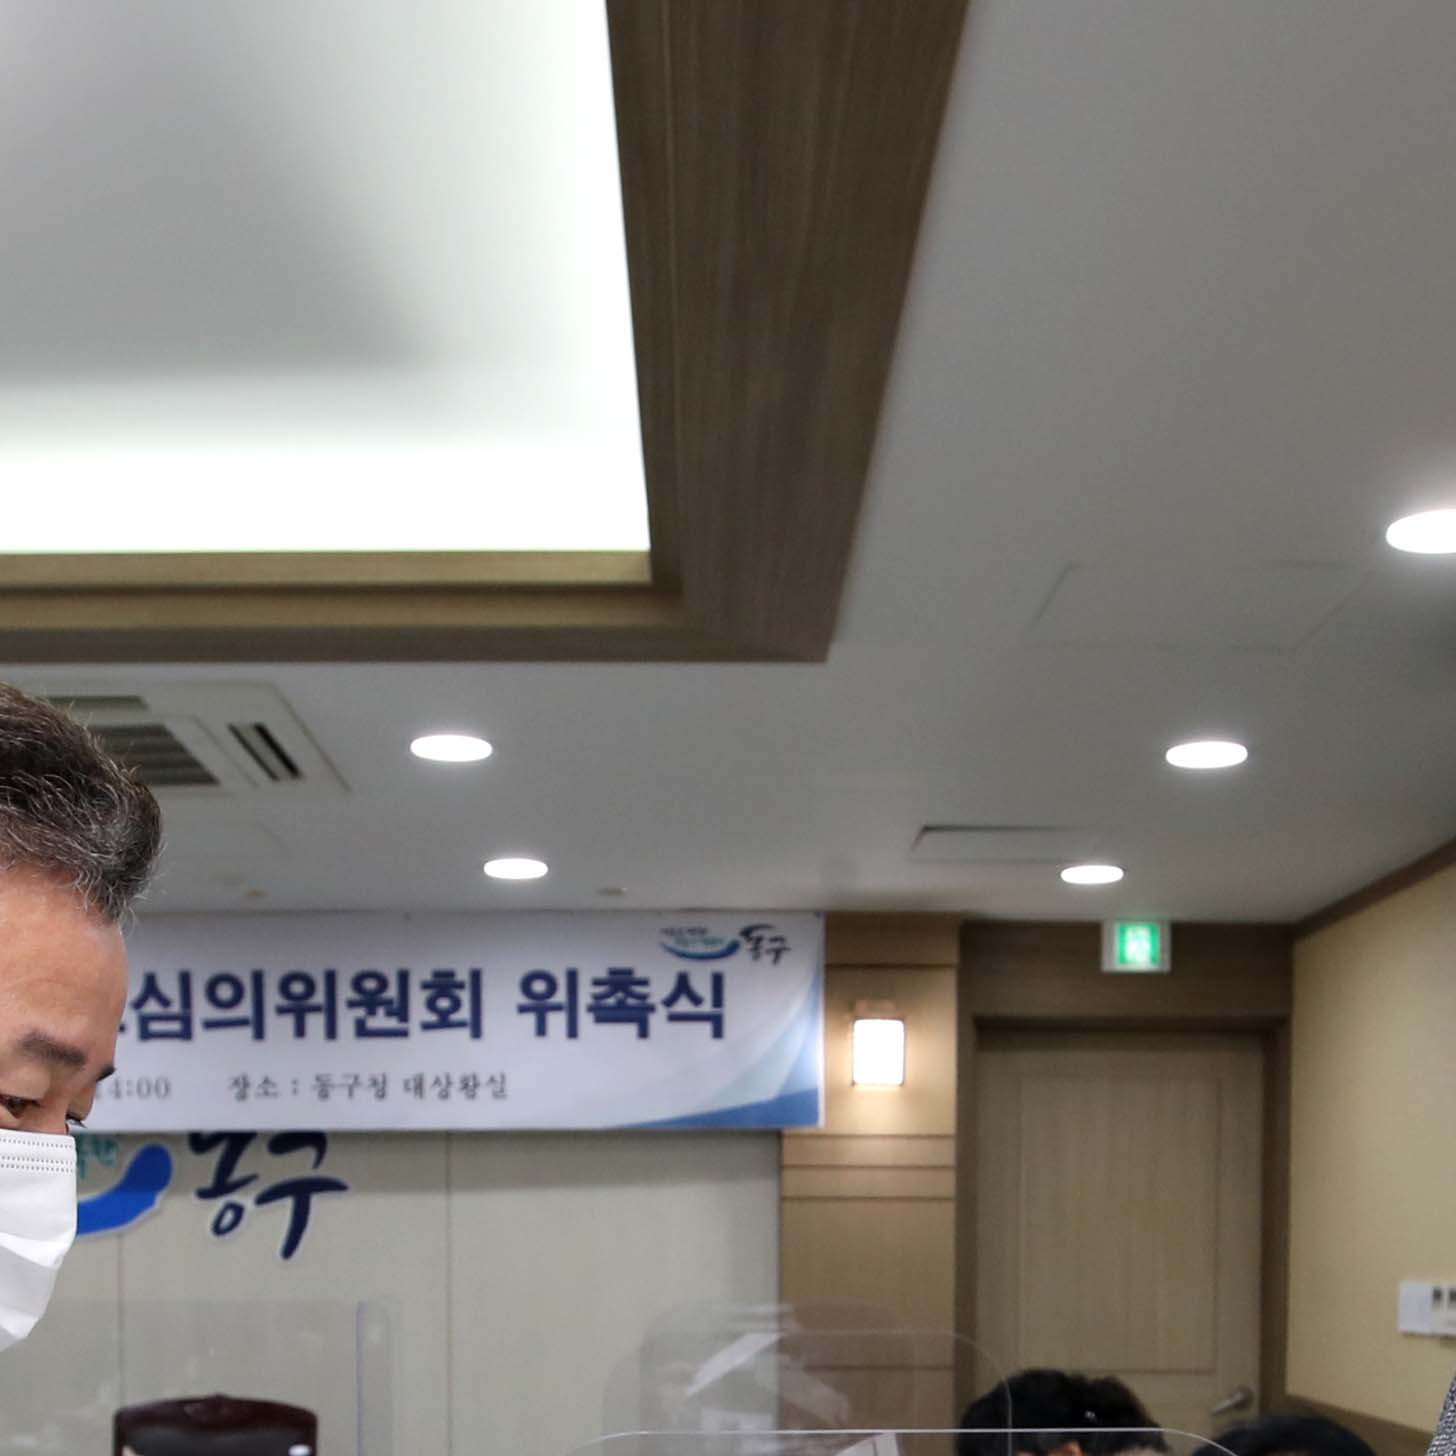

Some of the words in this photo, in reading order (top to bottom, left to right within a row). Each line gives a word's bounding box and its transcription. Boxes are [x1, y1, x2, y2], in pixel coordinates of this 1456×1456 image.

[739, 924, 791, 965] 동구
[118, 968, 483, 1042] 심의위원회
[515, 966, 726, 1040] 위촉식
[226, 1072, 280, 1102] 장소
[310, 1073, 389, 1102] 동구청
[401, 1071, 511, 1102] 대상황실
